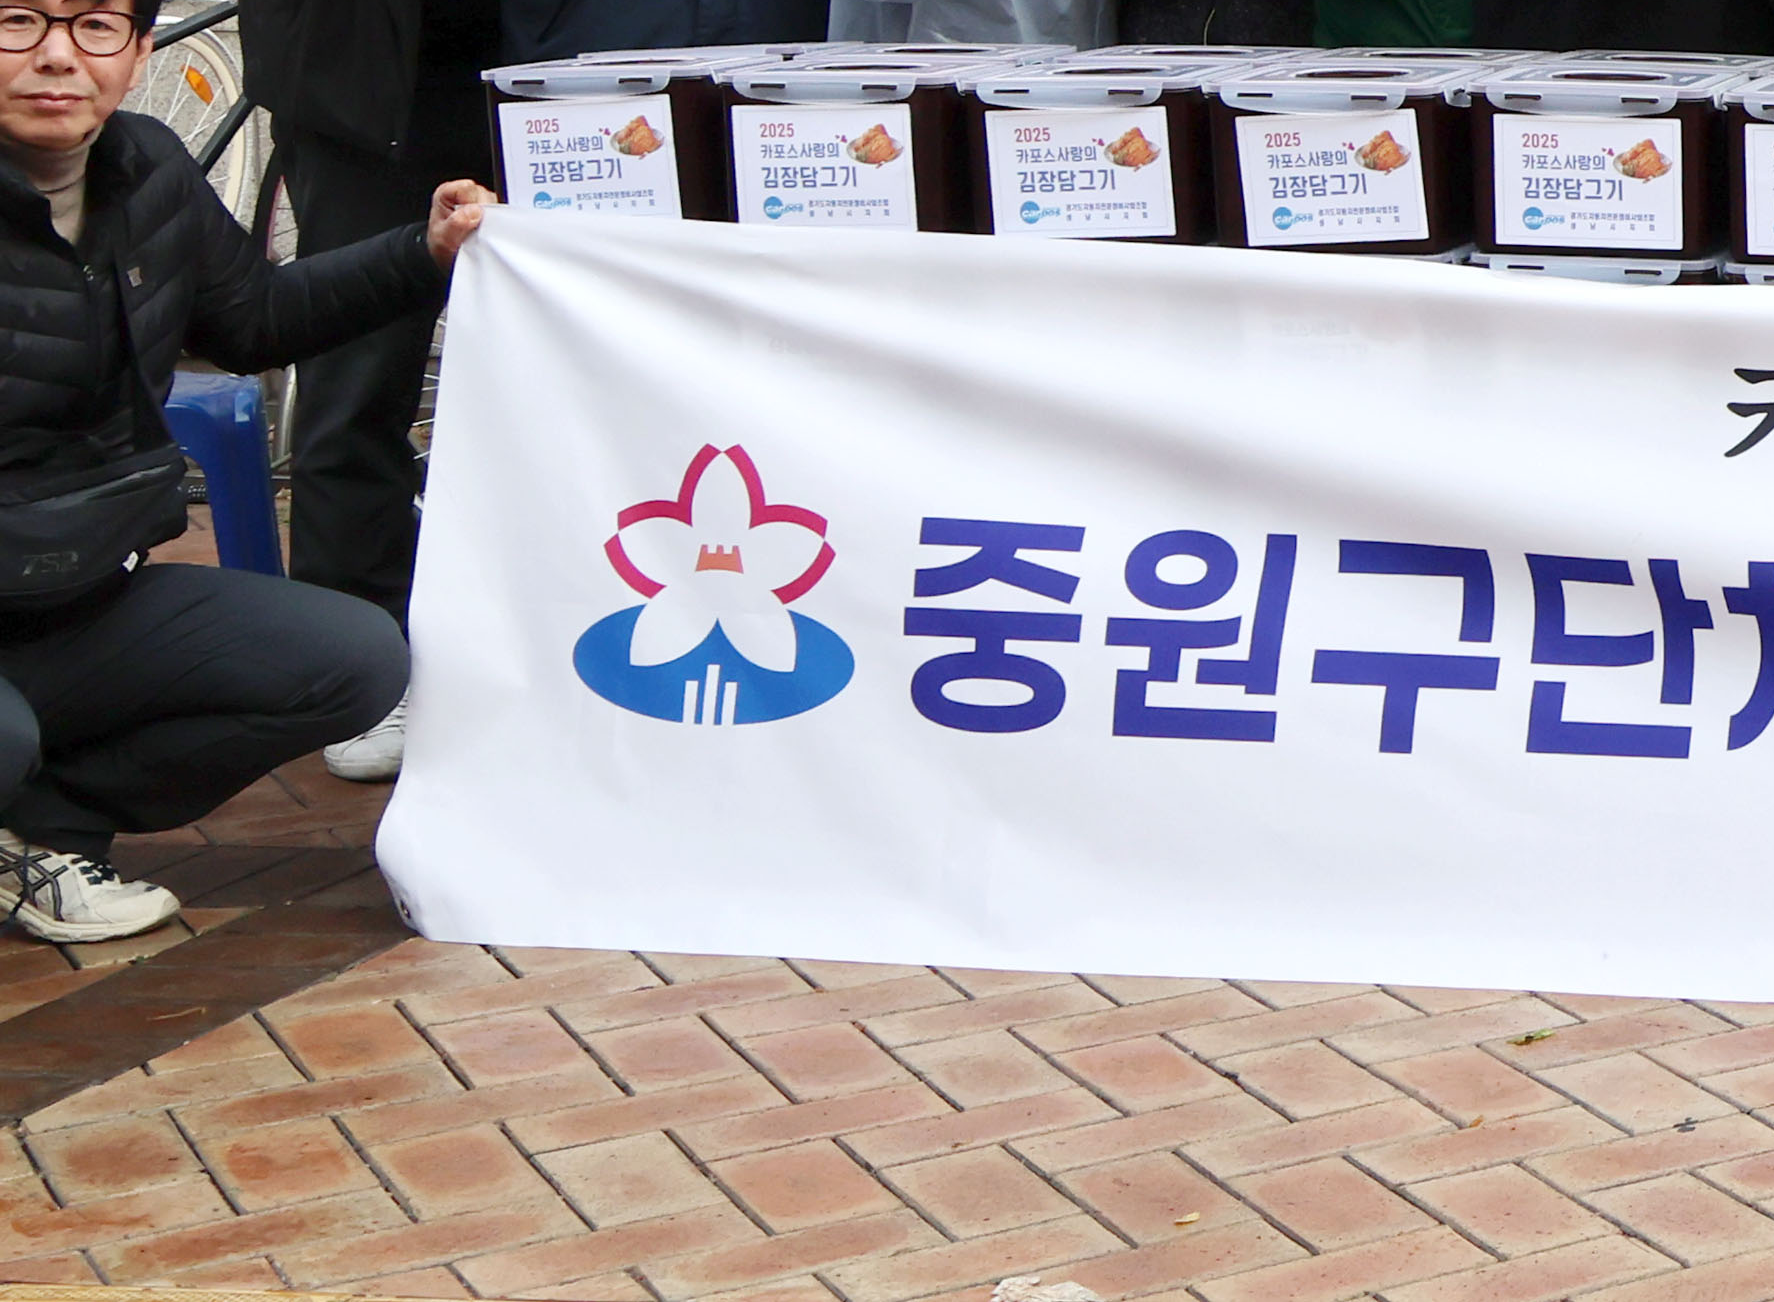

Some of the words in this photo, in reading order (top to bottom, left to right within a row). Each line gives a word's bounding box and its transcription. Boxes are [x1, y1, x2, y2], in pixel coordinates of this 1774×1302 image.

[525, 118, 559, 134] 2025
[759, 122, 794, 138] 2025
[1014, 127, 1050, 143] 2025
[527, 135, 604, 155] 카포스사랑의
[1265, 132, 1301, 148] 2025
[1522, 133, 1558, 149] 2025
[761, 142, 839, 159] 카포스사랑의
[1016, 146, 1097, 164] 카포스사랑의
[1267, 150, 1347, 169] 카포스사랑의
[529, 158, 622, 185] 김장담그기
[1523, 155, 1605, 171] 카포스사랑의
[761, 165, 857, 189] 김장담그기
[1017, 168, 1115, 194] 김장담그기
[1268, 173, 1367, 199] 김장담그기
[1522, 176, 1623, 201] 김장담그기
